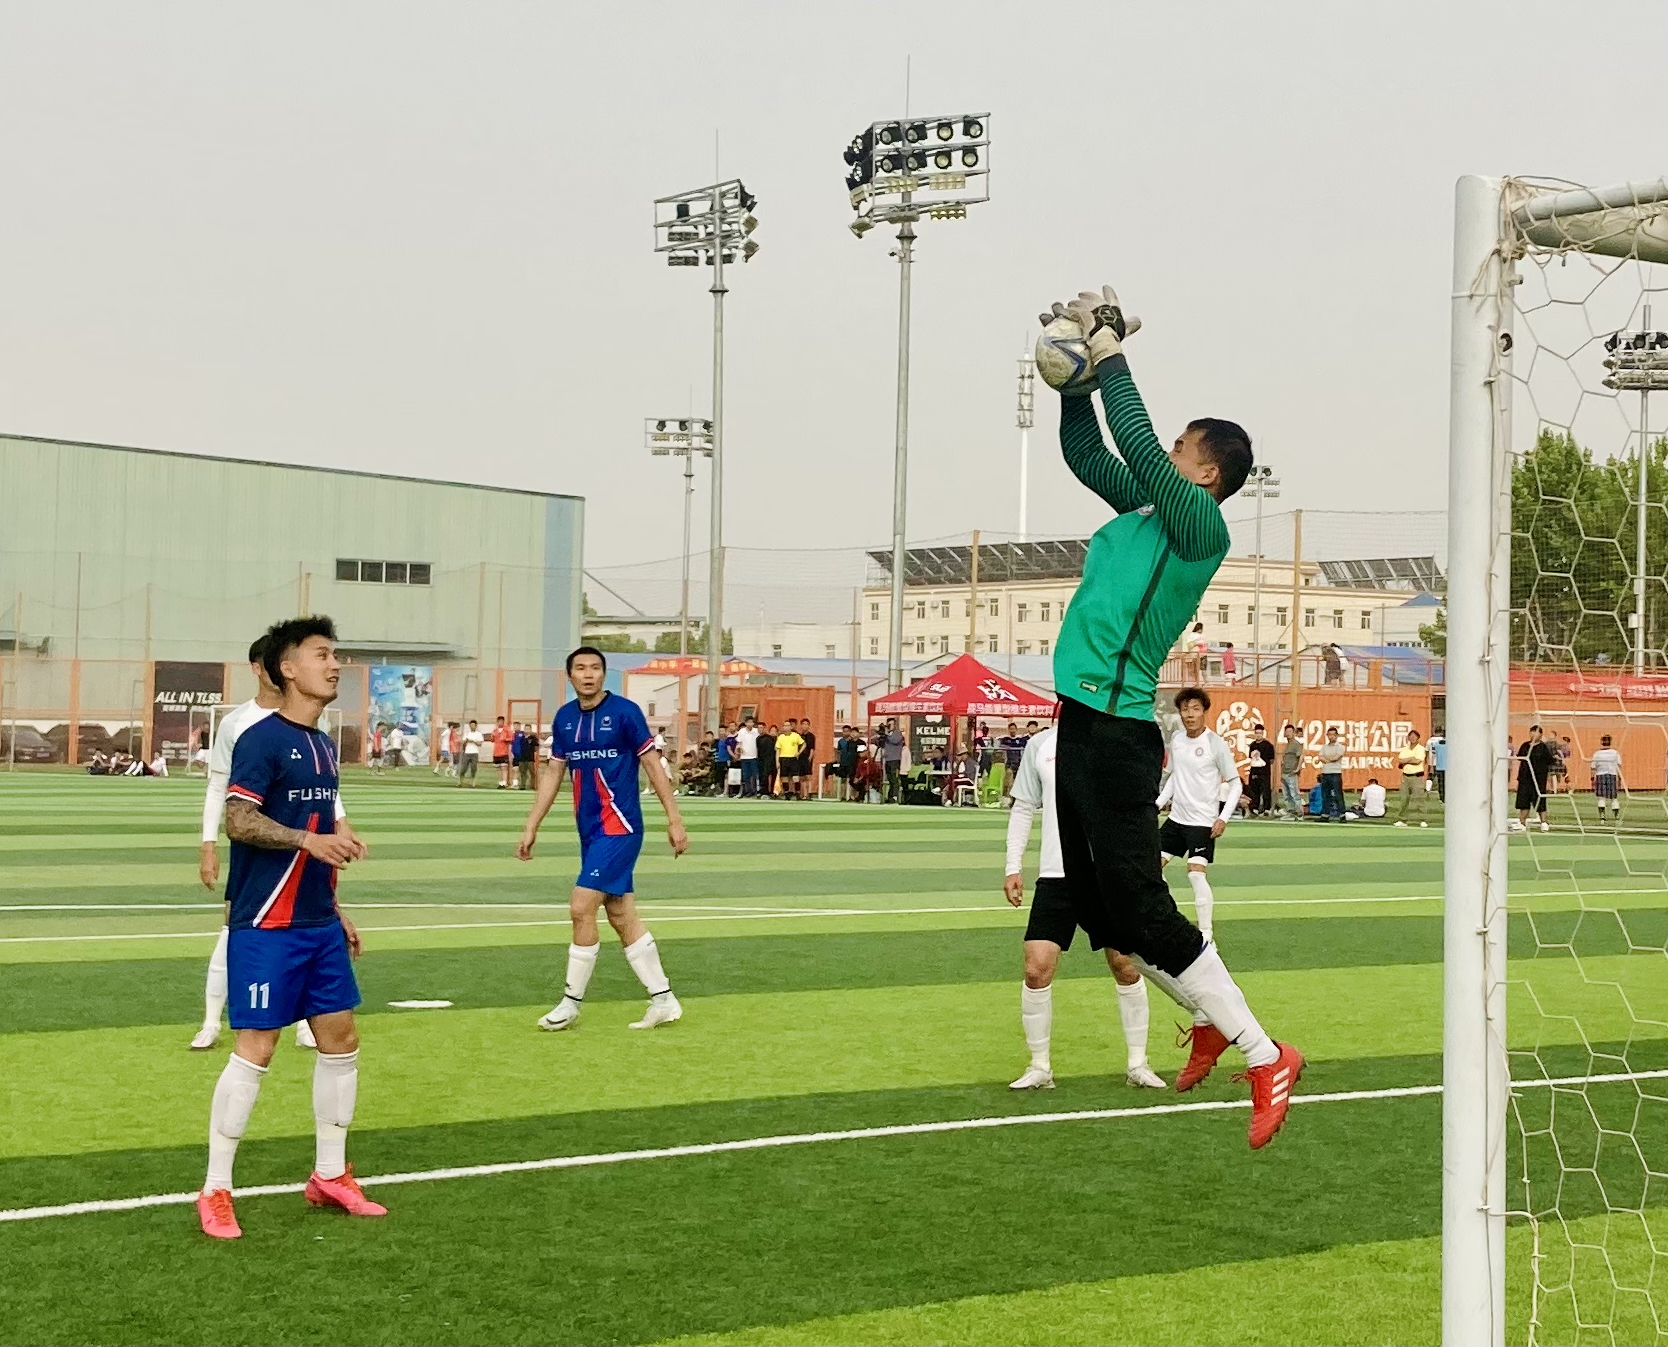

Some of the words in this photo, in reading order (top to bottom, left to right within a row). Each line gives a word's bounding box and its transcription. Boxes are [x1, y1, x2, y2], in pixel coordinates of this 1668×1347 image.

[153, 691, 177, 704] ALL
[178, 691, 195, 704] IN
[916, 726, 952, 736] KELME
[248, 982, 270, 1009] 11
